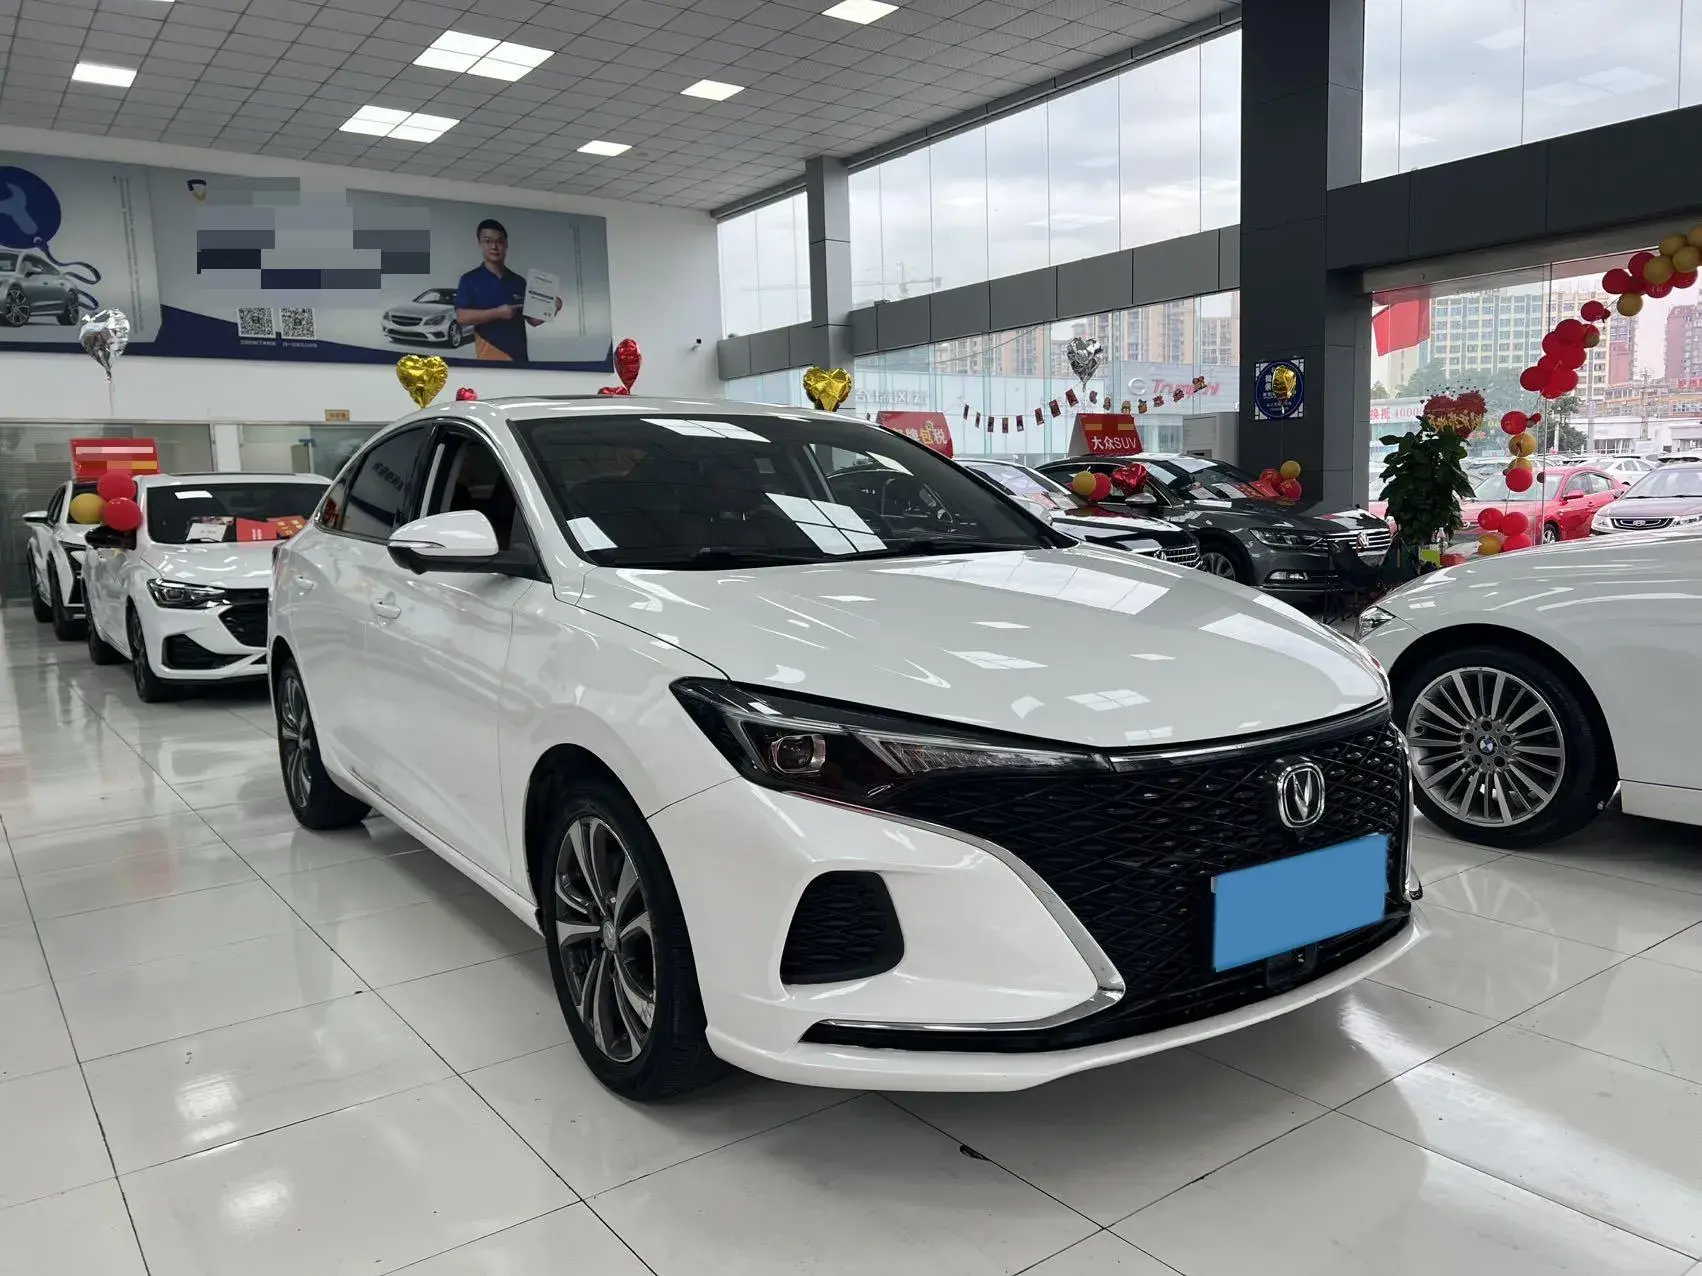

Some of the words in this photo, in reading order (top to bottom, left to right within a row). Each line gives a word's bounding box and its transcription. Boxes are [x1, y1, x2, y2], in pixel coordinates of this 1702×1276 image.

[892, 427, 947, 445] 牌包税
[1091, 436, 1136, 450] 大众SUV
